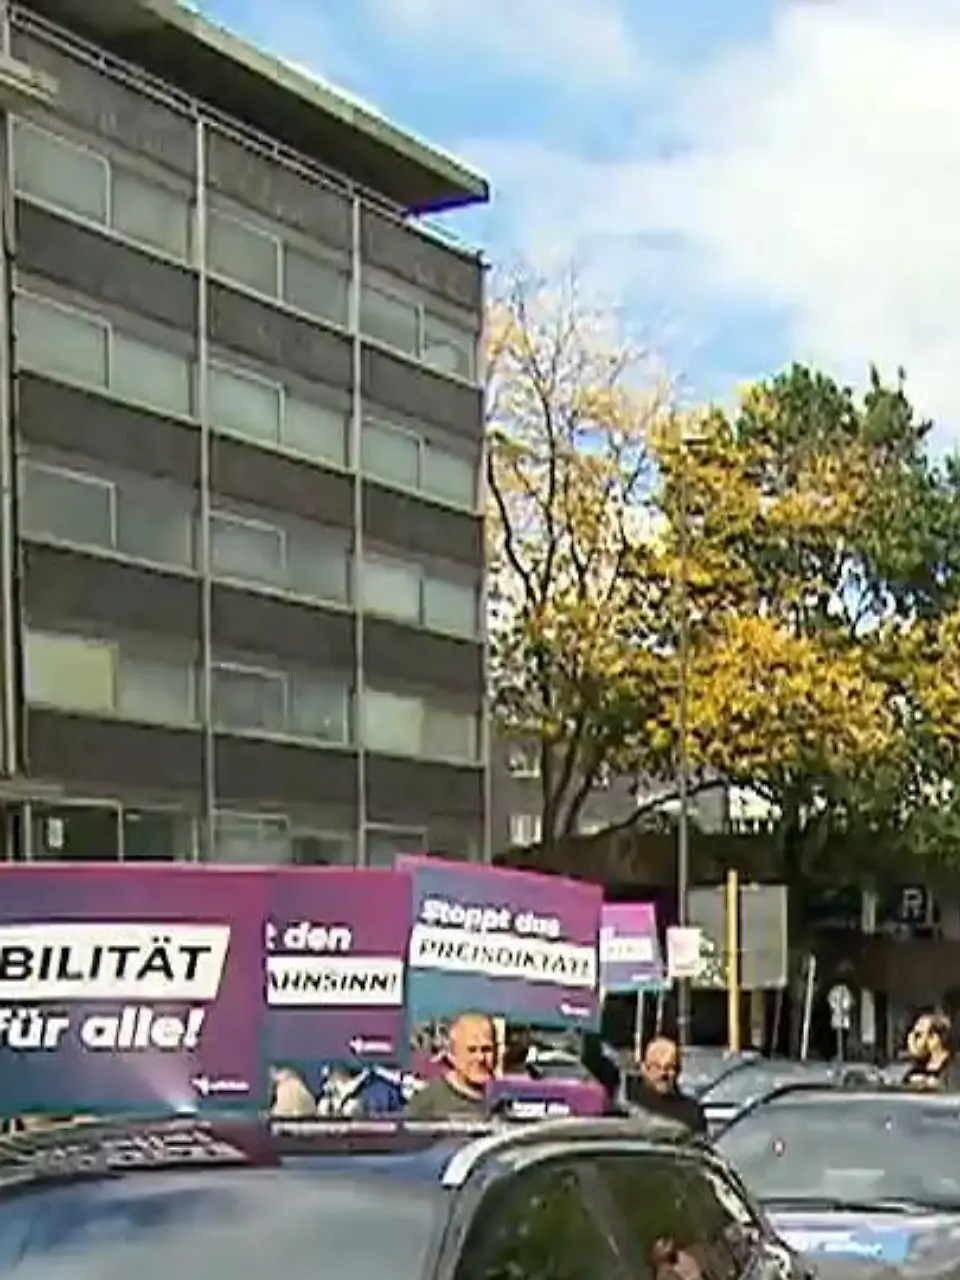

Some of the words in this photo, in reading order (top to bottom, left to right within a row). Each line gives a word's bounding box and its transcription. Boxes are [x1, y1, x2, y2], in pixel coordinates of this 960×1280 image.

[284, 921, 352, 951] den
[421, 899, 511, 935] Stoppt
[514, 911, 561, 938] das
[0, 936, 212, 981] BILITÄT
[0, 1007, 70, 1049] für
[81, 1003, 205, 1048] alle!
